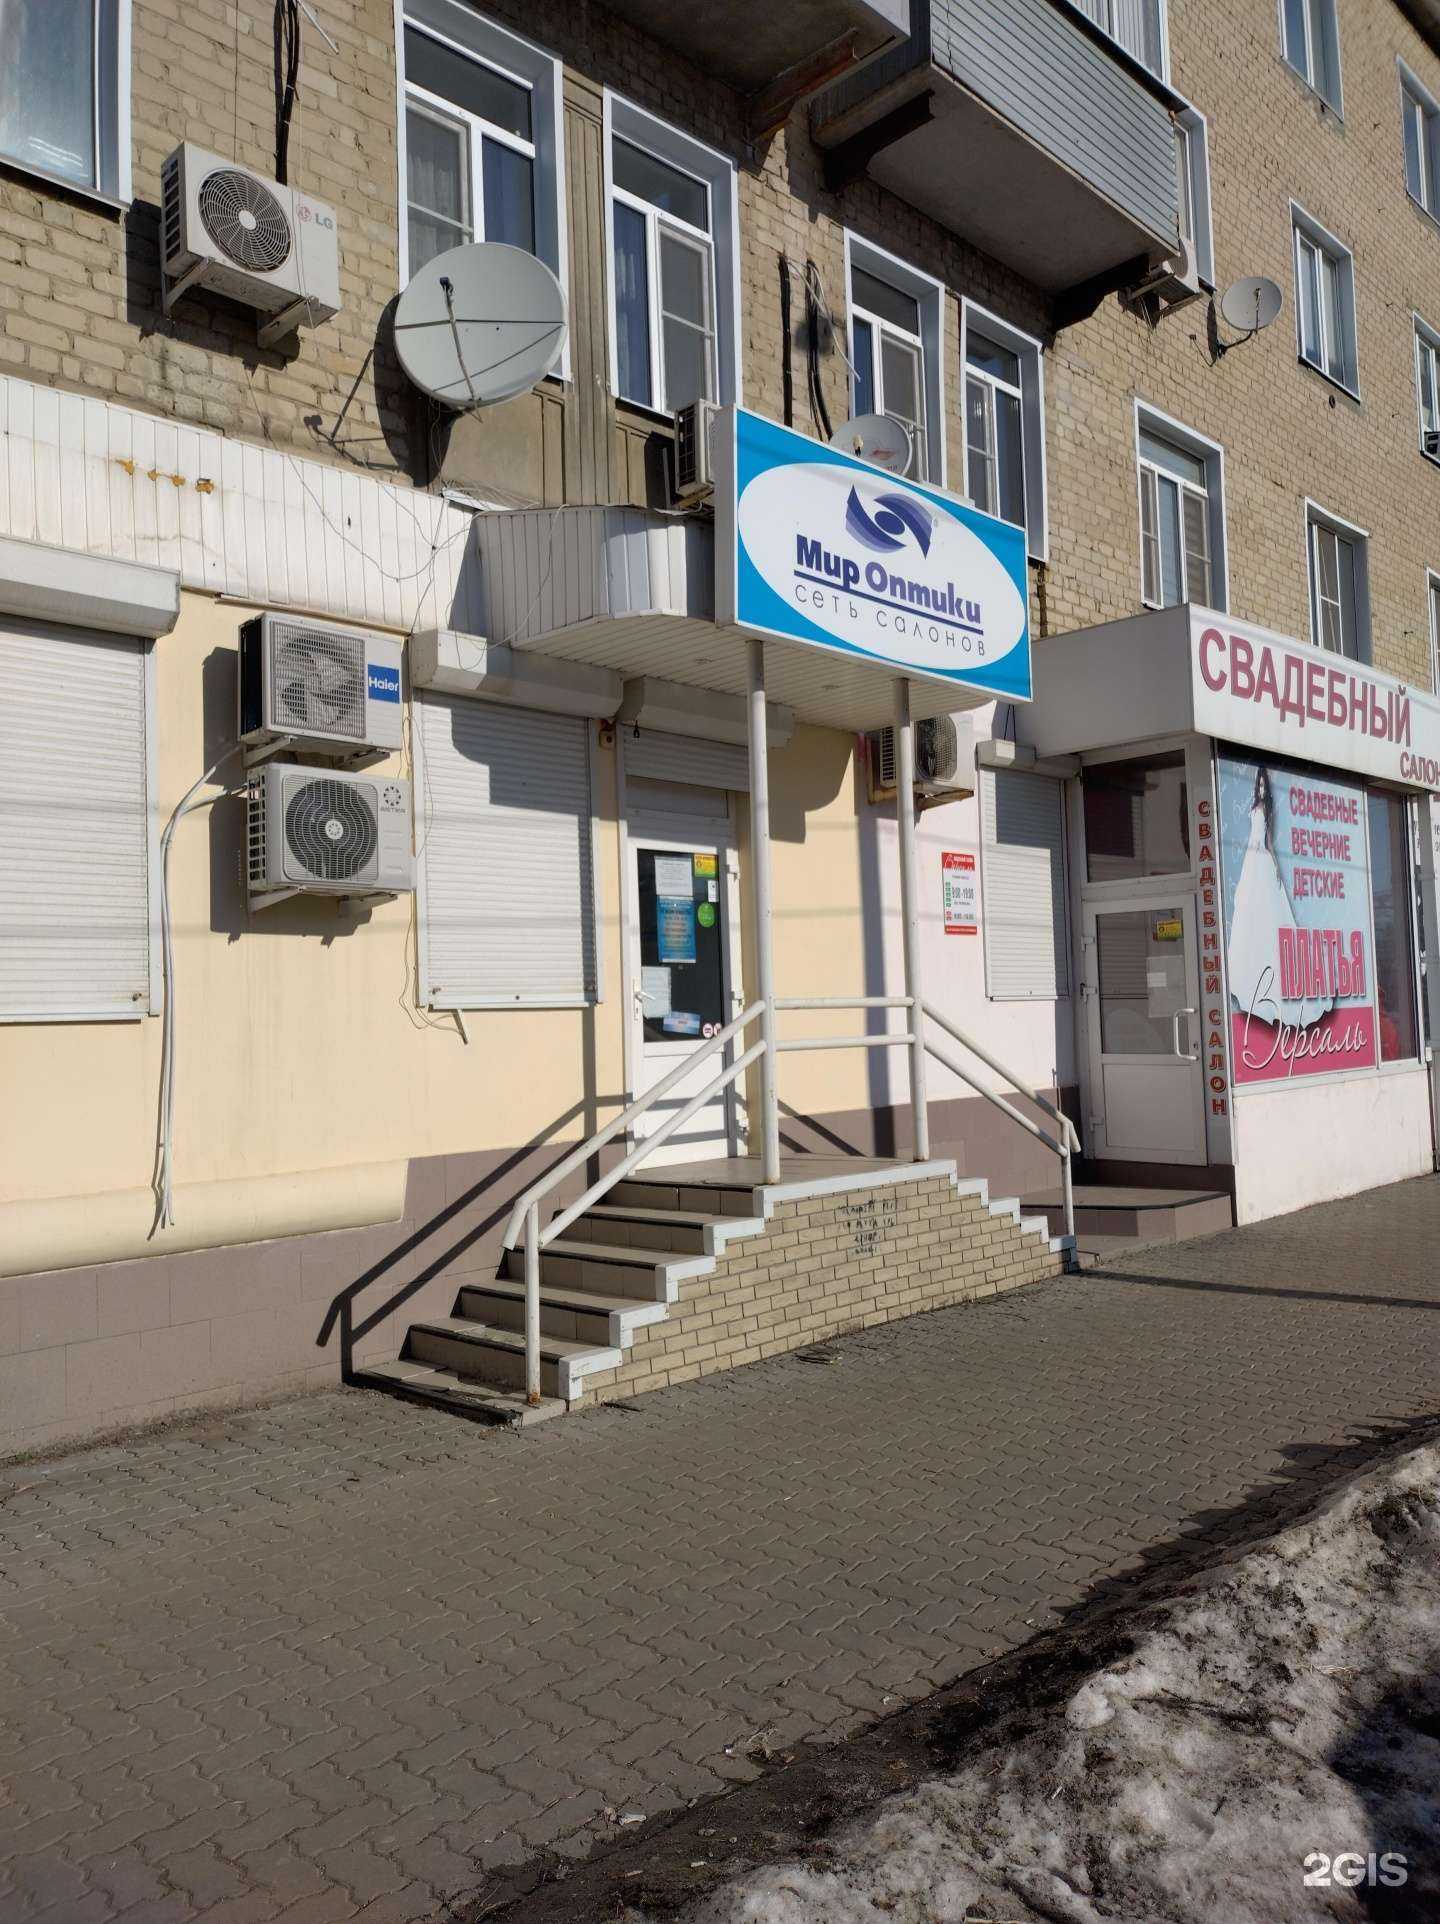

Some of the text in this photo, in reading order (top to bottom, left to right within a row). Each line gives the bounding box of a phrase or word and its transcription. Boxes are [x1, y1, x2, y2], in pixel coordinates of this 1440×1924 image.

[315, 212, 334, 231] LG
[796, 533, 982, 625] Мир Оптики
[794, 583, 986, 657] сеть салонов
[368, 676, 399, 692] Haier
[1199, 627, 1412, 748] СВАДЕБНЫЙ
[1289, 785, 1359, 826] СВАДЕБНЫЕ
[1291, 826, 1352, 862] ВЕЧЕРНИЕ
[1293, 866, 1346, 899] ДЕТСКИЕ
[1198, 800, 1227, 1116] СВАДЕБНЫЙ САЛОН
[1278, 927, 1368, 1000] ПЛАТЬЯ
[1242, 966, 1368, 1078] Версаль
